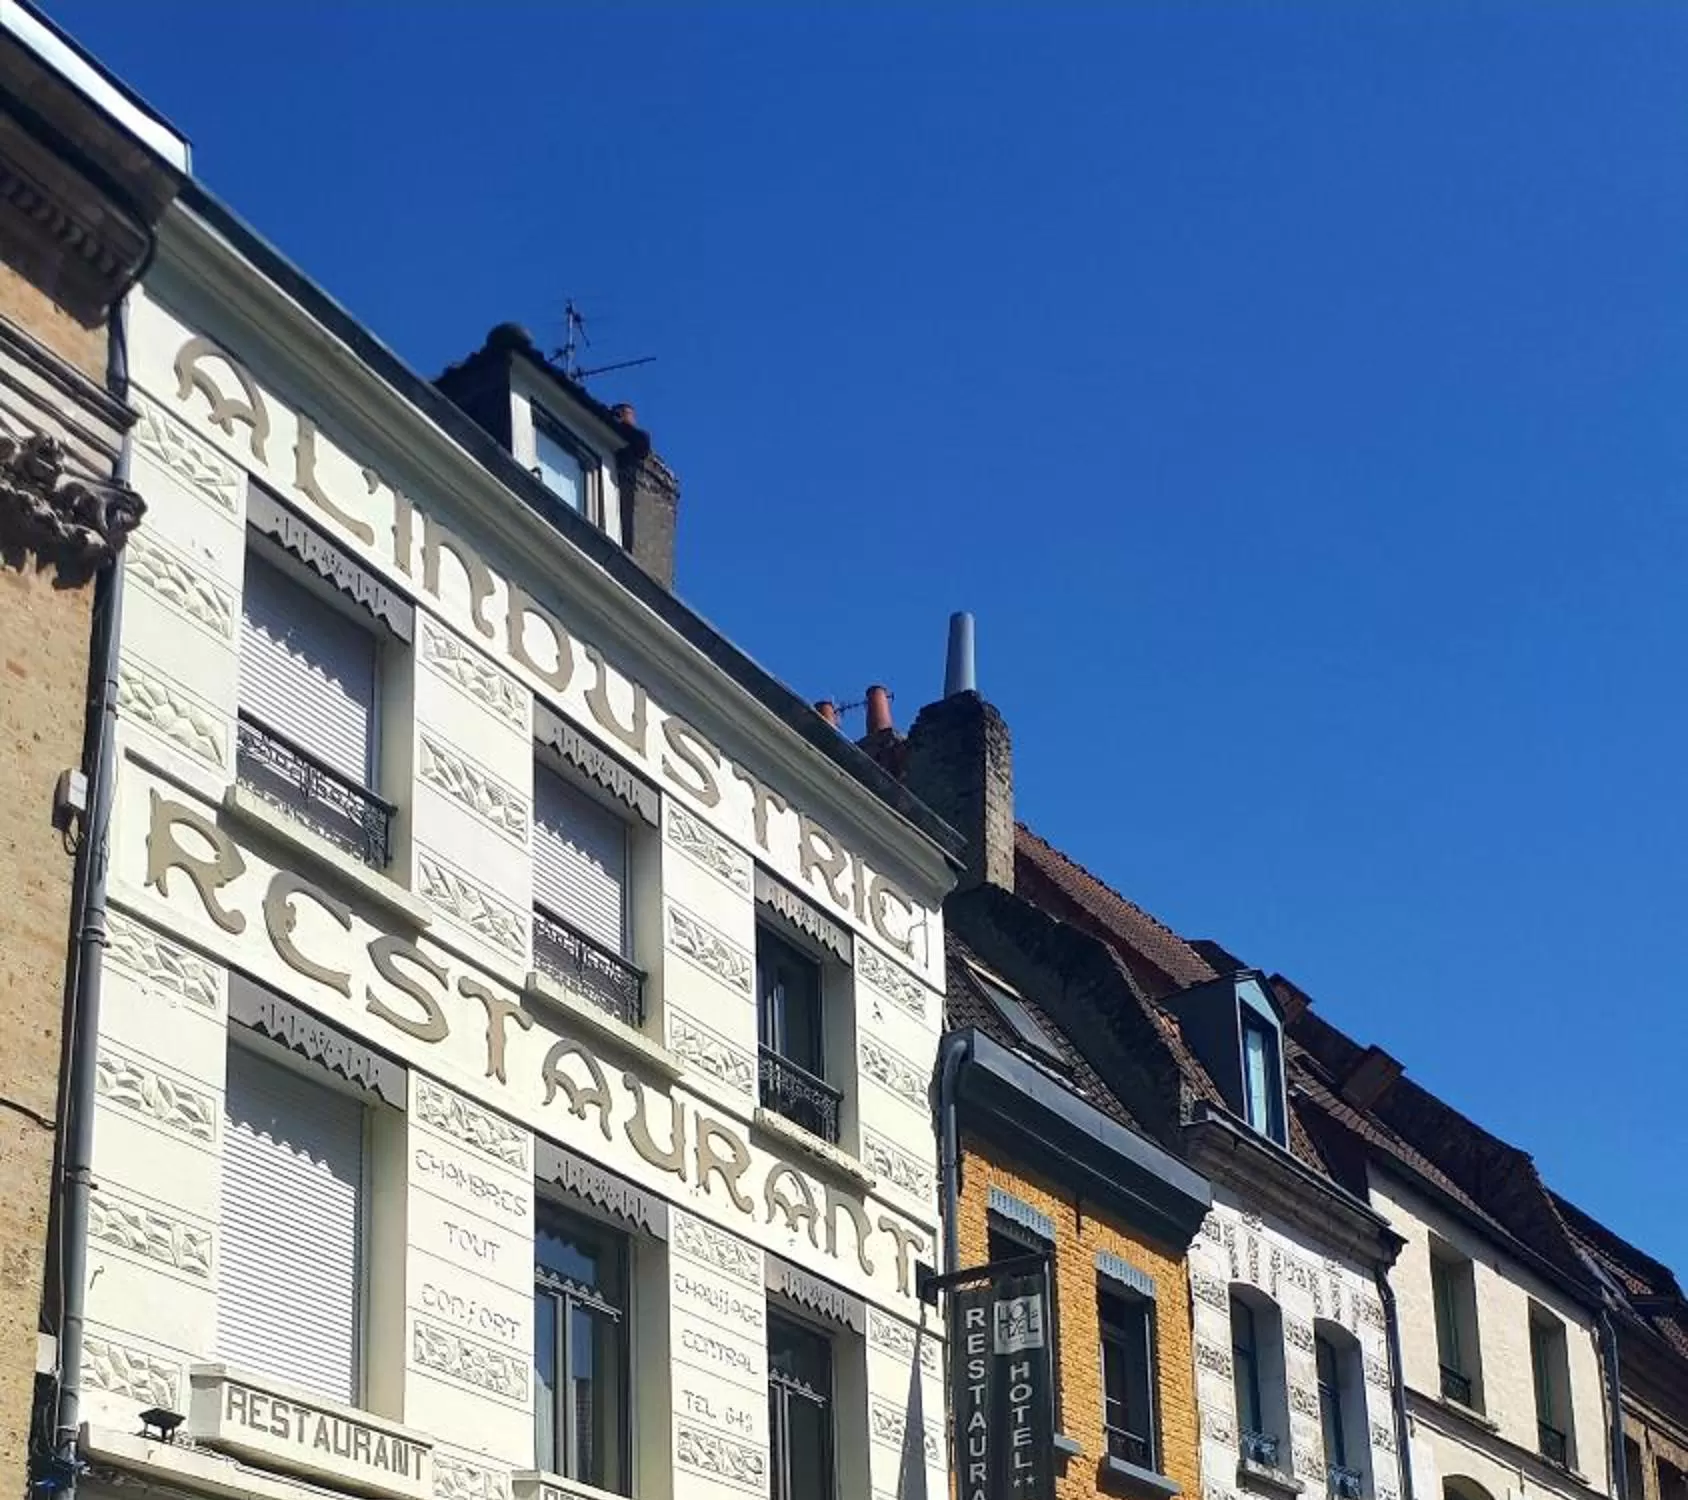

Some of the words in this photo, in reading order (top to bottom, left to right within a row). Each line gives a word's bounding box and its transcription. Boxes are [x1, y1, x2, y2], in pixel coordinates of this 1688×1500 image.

[144, 786, 925, 1298] RESTAURANT
[415, 1149, 528, 1217] CHAMBRES
[443, 1221, 500, 1262] TOUT
[422, 1283, 521, 1340] CONFORT
[681, 1328, 759, 1375] CENTRAL
[226, 1384, 428, 1481] RESTAURANT
[682, 1389, 716, 1420] TEL
[1008, 1361, 1033, 1469] HOTEL
